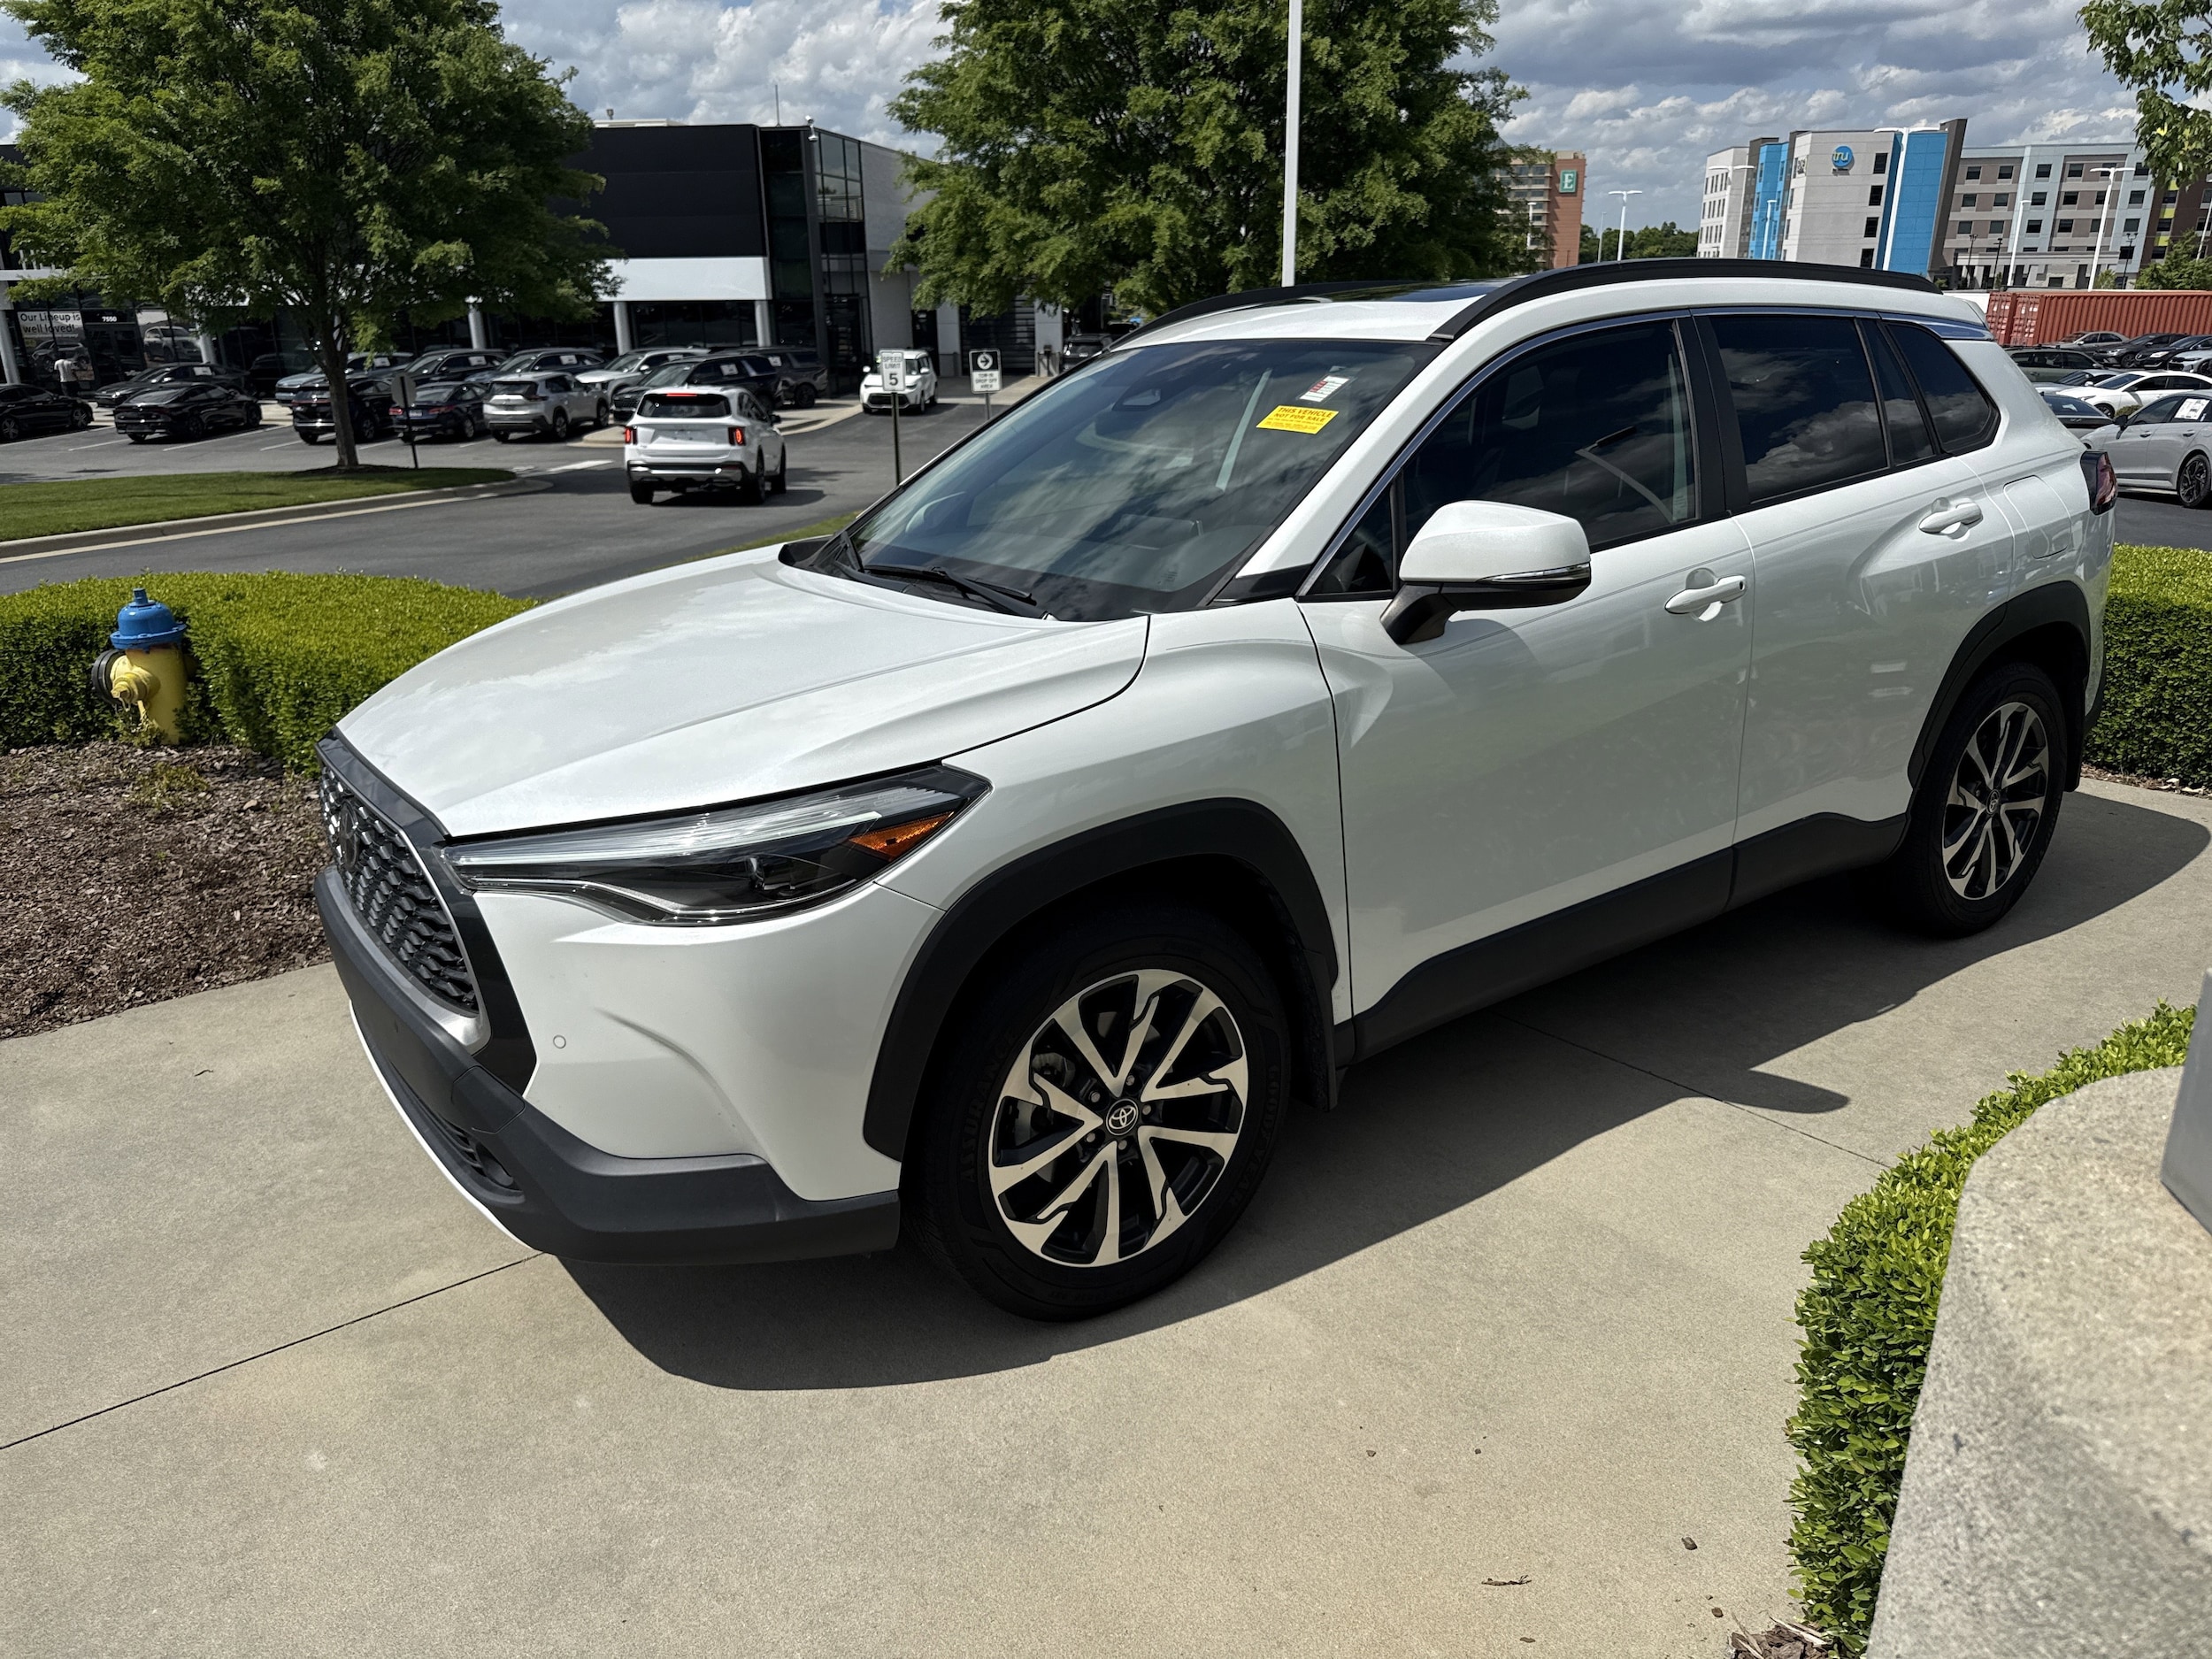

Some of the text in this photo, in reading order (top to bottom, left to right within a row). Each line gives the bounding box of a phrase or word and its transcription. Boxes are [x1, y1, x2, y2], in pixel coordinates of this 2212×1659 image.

[1563, 173, 1574, 189] E
[73, 311, 81, 321] is
[23, 323, 74, 334] well loved!
[889, 373, 898, 386] 5
[1298, 409, 1334, 418] VEHICLE
